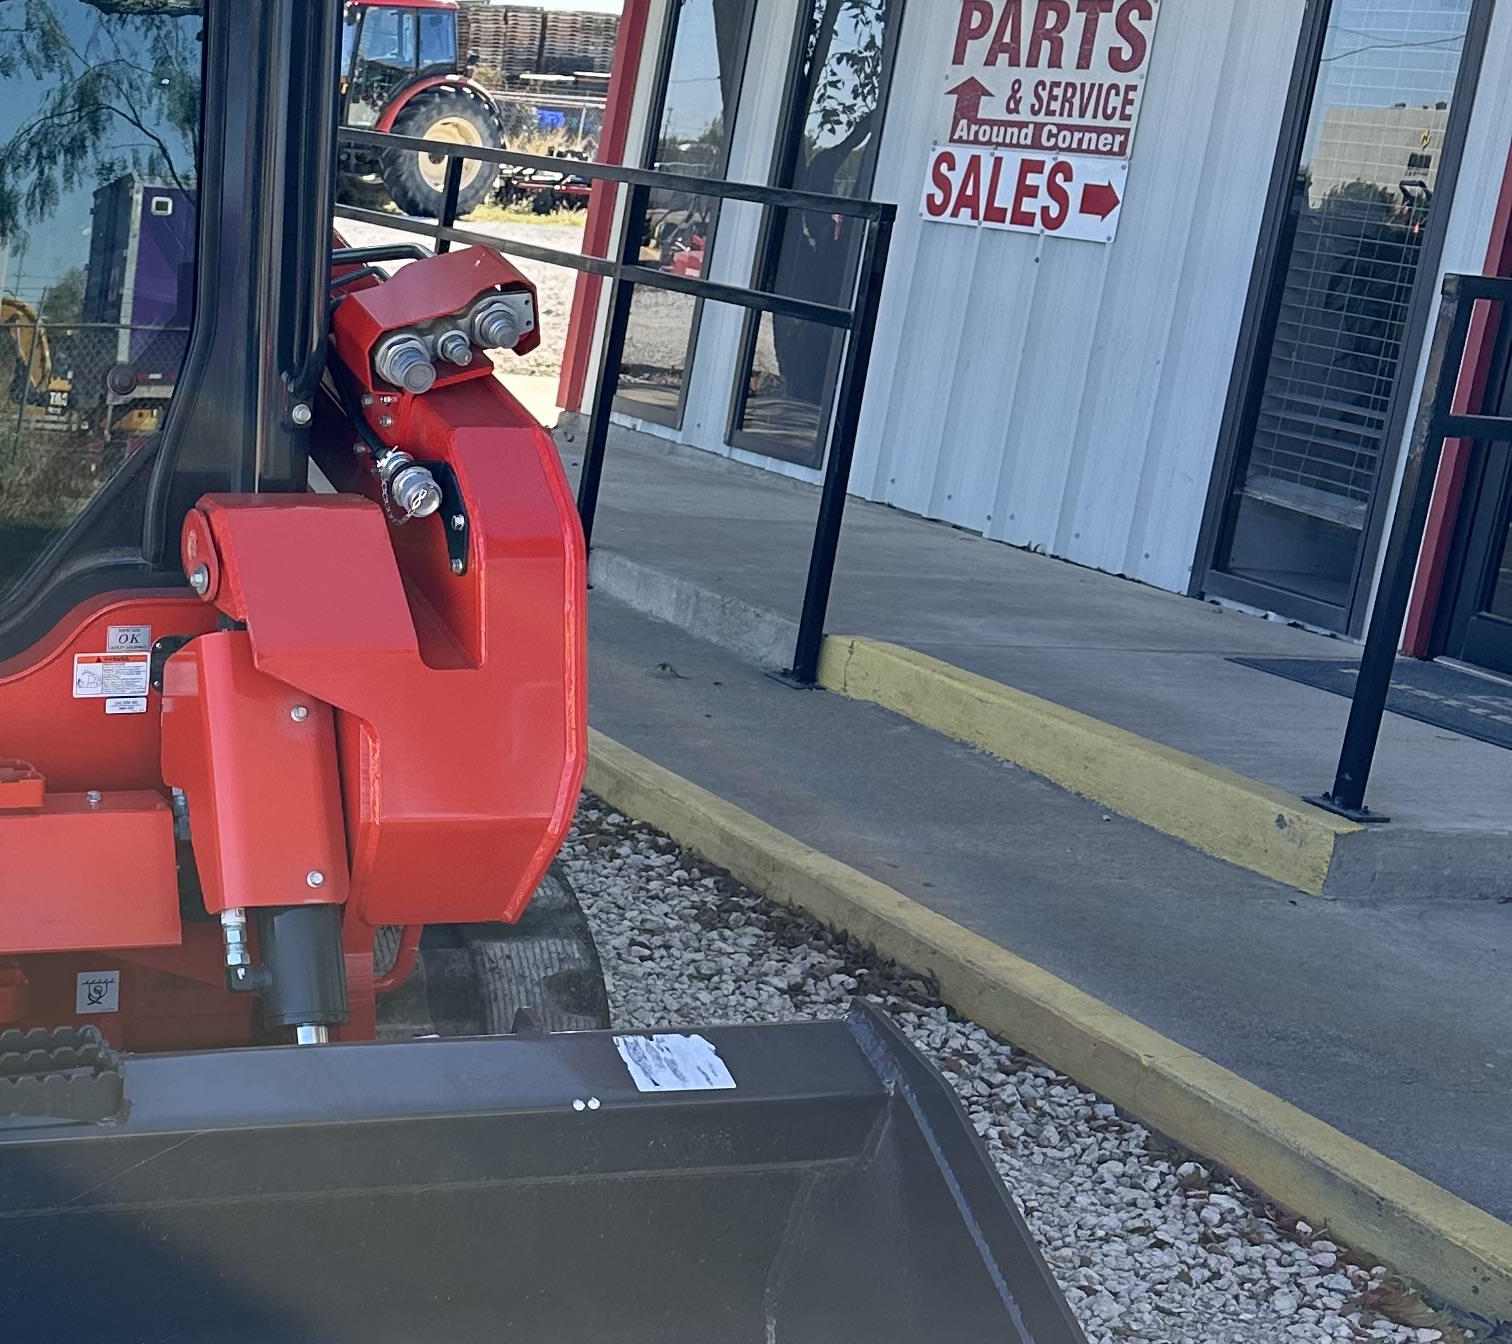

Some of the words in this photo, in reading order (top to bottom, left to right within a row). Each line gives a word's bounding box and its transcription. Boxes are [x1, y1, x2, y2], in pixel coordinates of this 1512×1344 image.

[1005, 78, 1023, 115] &
[1030, 79, 1138, 122] SERVICE
[953, 118, 1034, 146] Around
[1041, 123, 1125, 152] Corner
[925, 151, 1074, 231] SALES
[118, 633, 141, 645] OK
